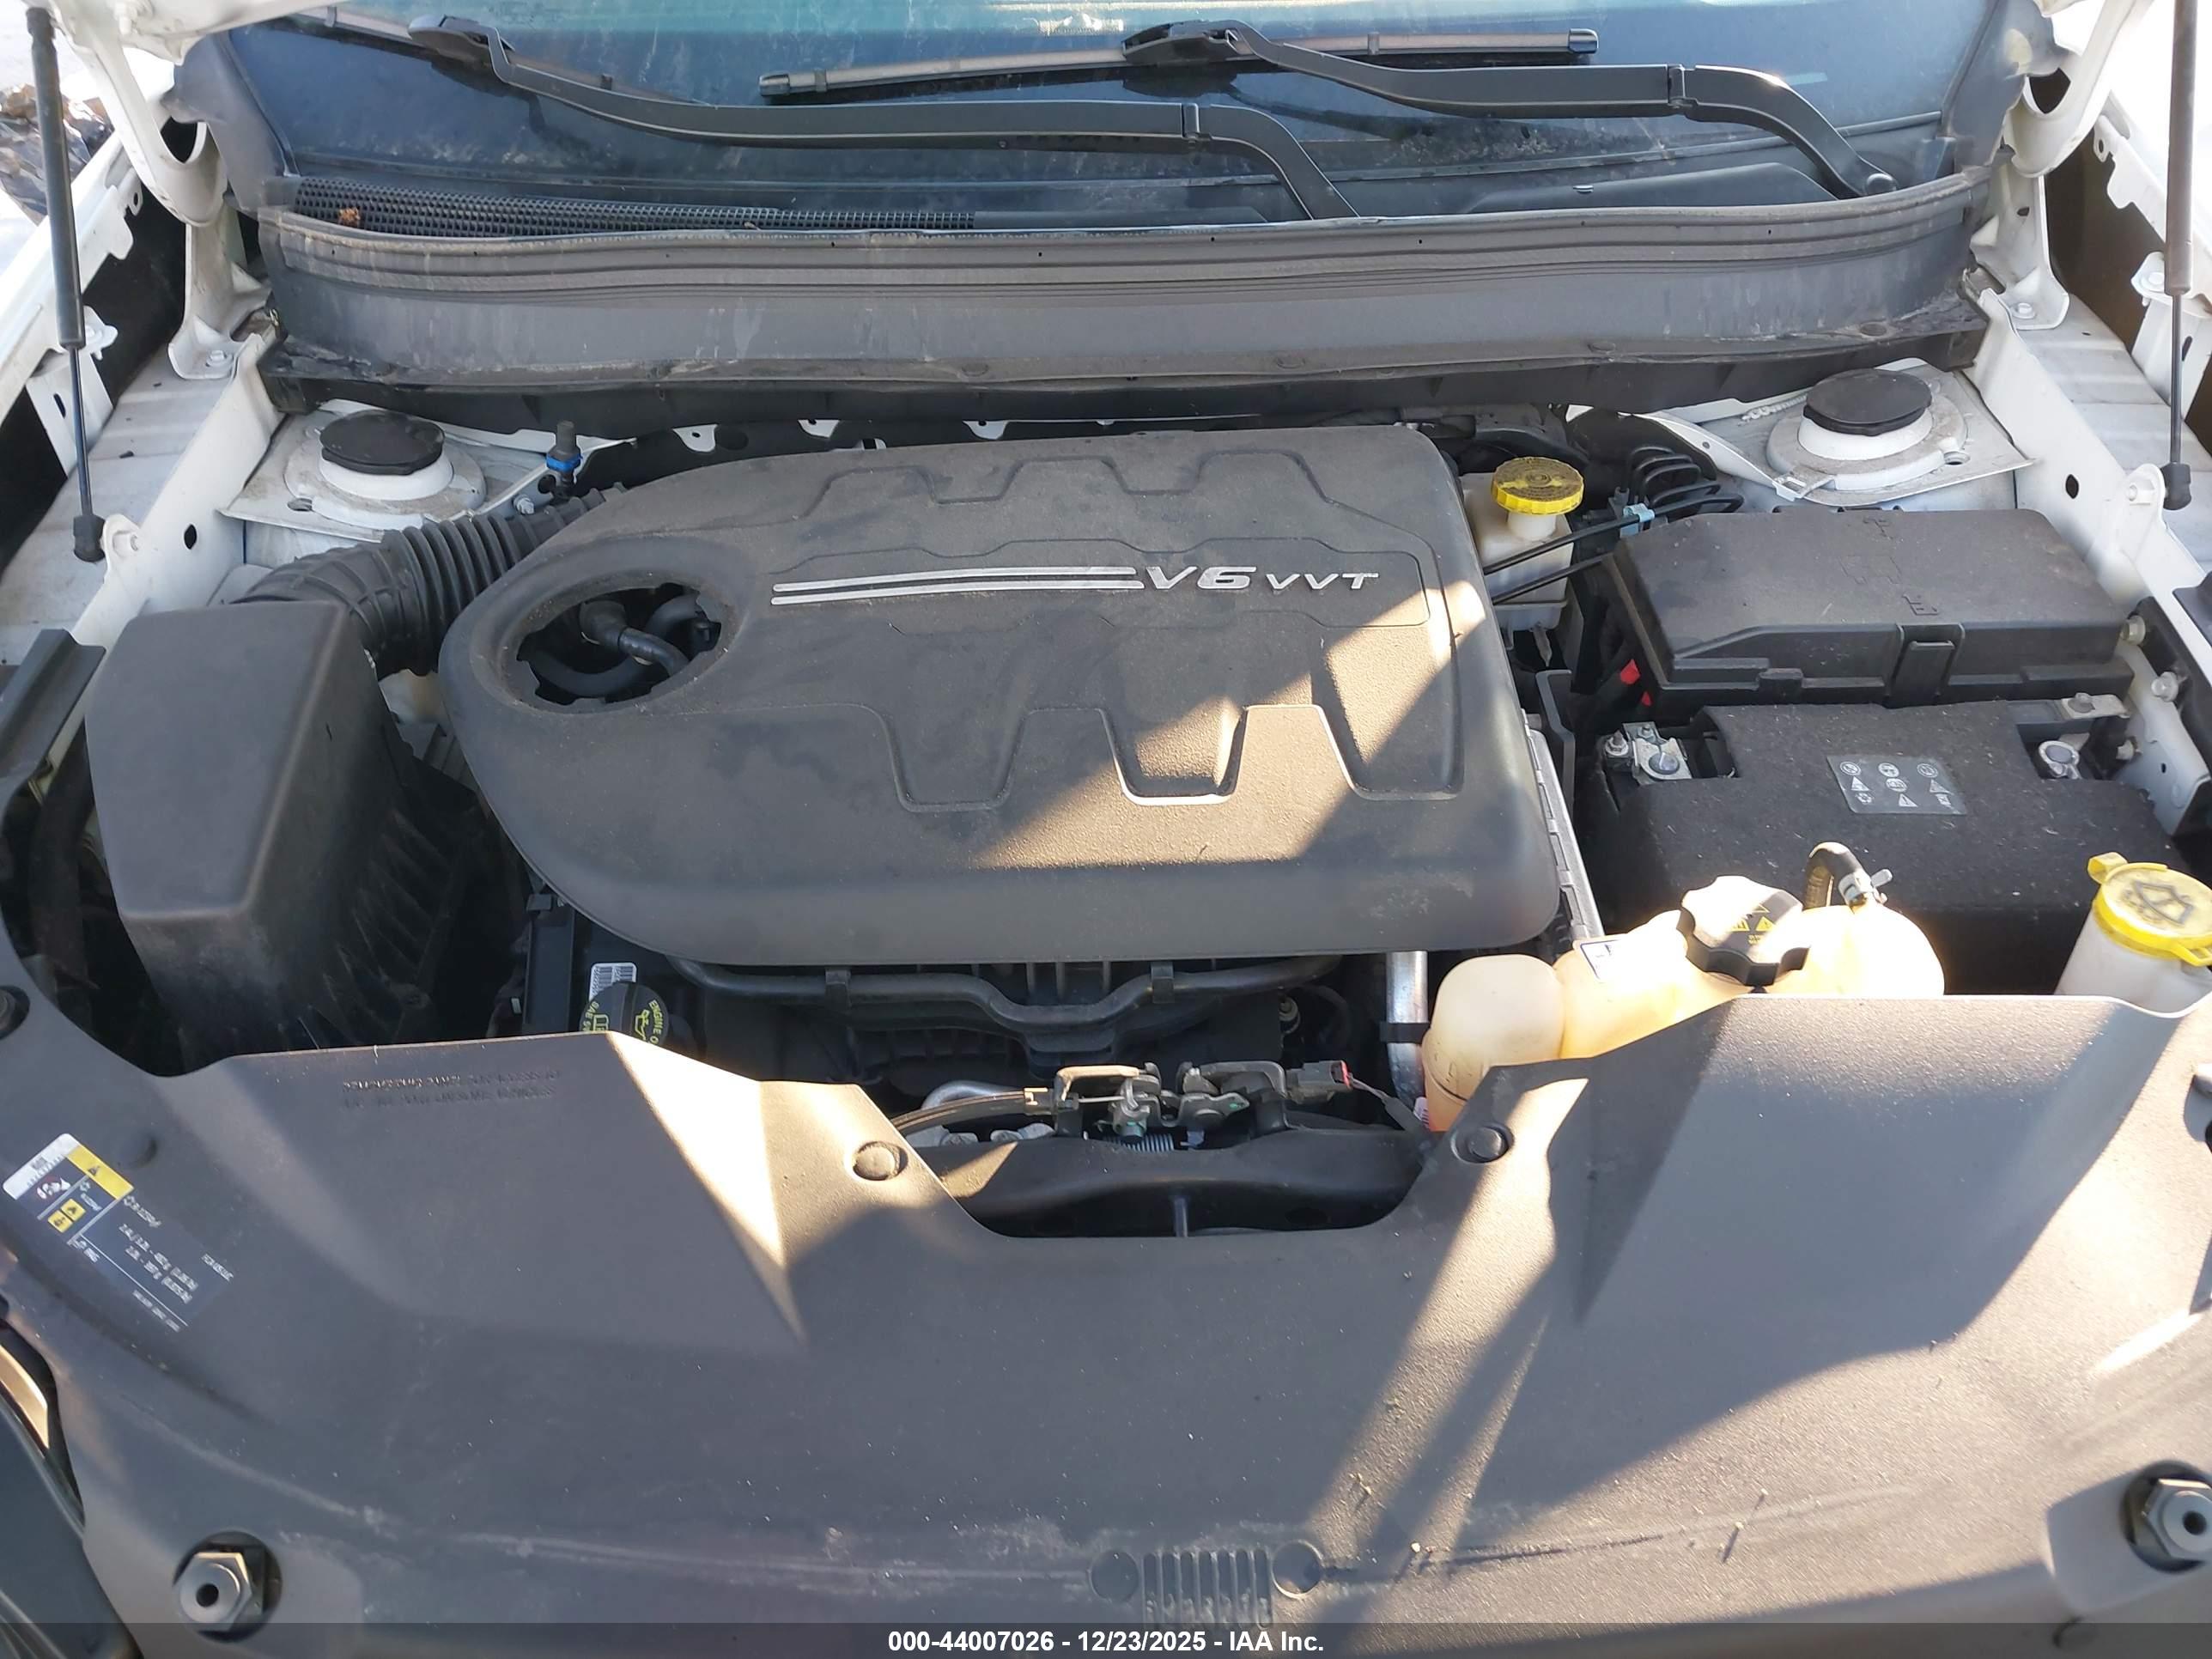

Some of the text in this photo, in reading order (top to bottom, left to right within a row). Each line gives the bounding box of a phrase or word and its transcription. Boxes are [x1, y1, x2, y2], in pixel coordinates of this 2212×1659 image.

[1146, 565, 1379, 590] V6 VVT
[647, 1000, 664, 1036] ENGINE
